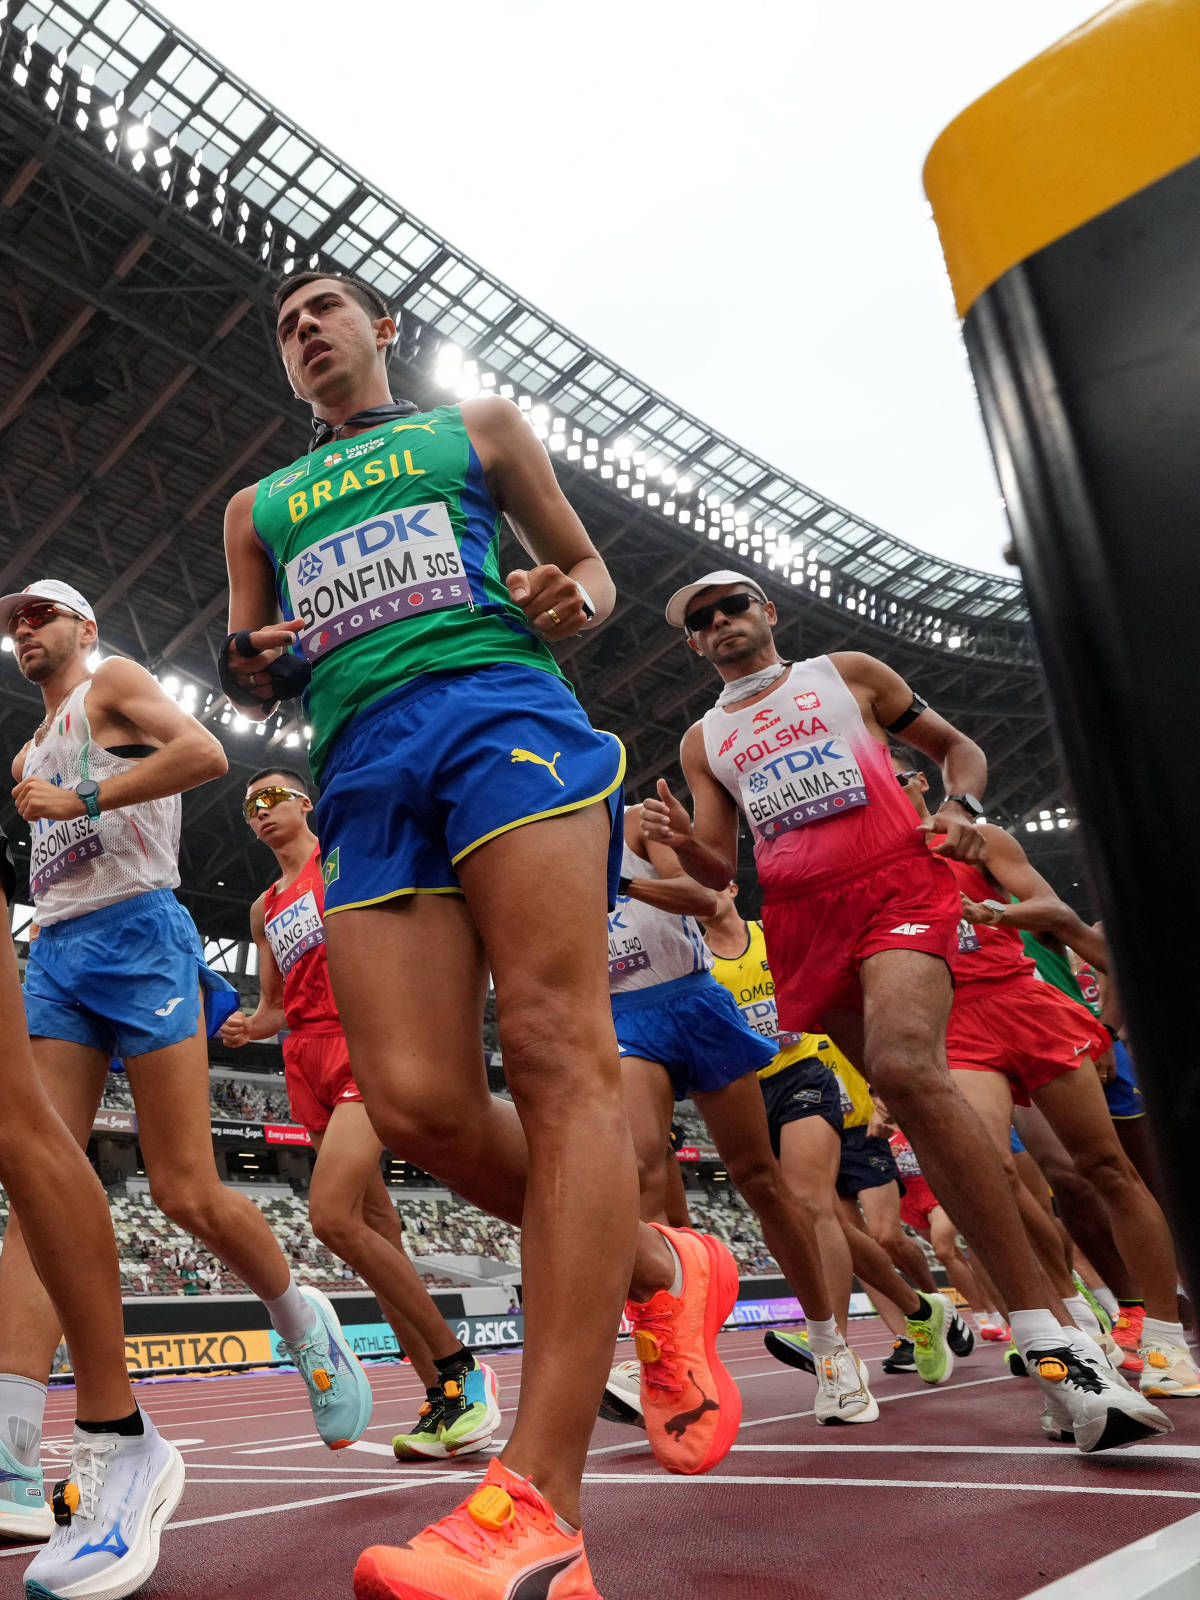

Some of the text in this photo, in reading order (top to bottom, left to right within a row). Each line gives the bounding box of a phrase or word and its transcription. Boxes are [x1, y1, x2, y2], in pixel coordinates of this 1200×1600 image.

[346, 437, 385, 455] loterias
[288, 450, 425, 524] BRASIL
[319, 508, 439, 567] TDK
[298, 551, 460, 632] BONFIM 305
[431, 584, 462, 601] 25
[754, 716, 781, 735] ORLEN
[733, 716, 829, 772] POLSKA
[763, 740, 844, 781] TDK
[749, 768, 863, 822] BEN HLIMA 371
[849, 791, 867, 802] 25
[72, 816, 94, 840] 352
[79, 843, 98, 857] 25
[268, 896, 310, 936] TDK
[305, 914, 319, 932] 313
[308, 932, 323, 944] 25
[622, 936, 642, 954] 340
[628, 956, 645, 967] 25
[737, 981, 775, 1007] OMB
[744, 1304, 774, 1322] TDK
[474, 1321, 520, 1345] asics
[125, 1335, 247, 1369] SEIKO
